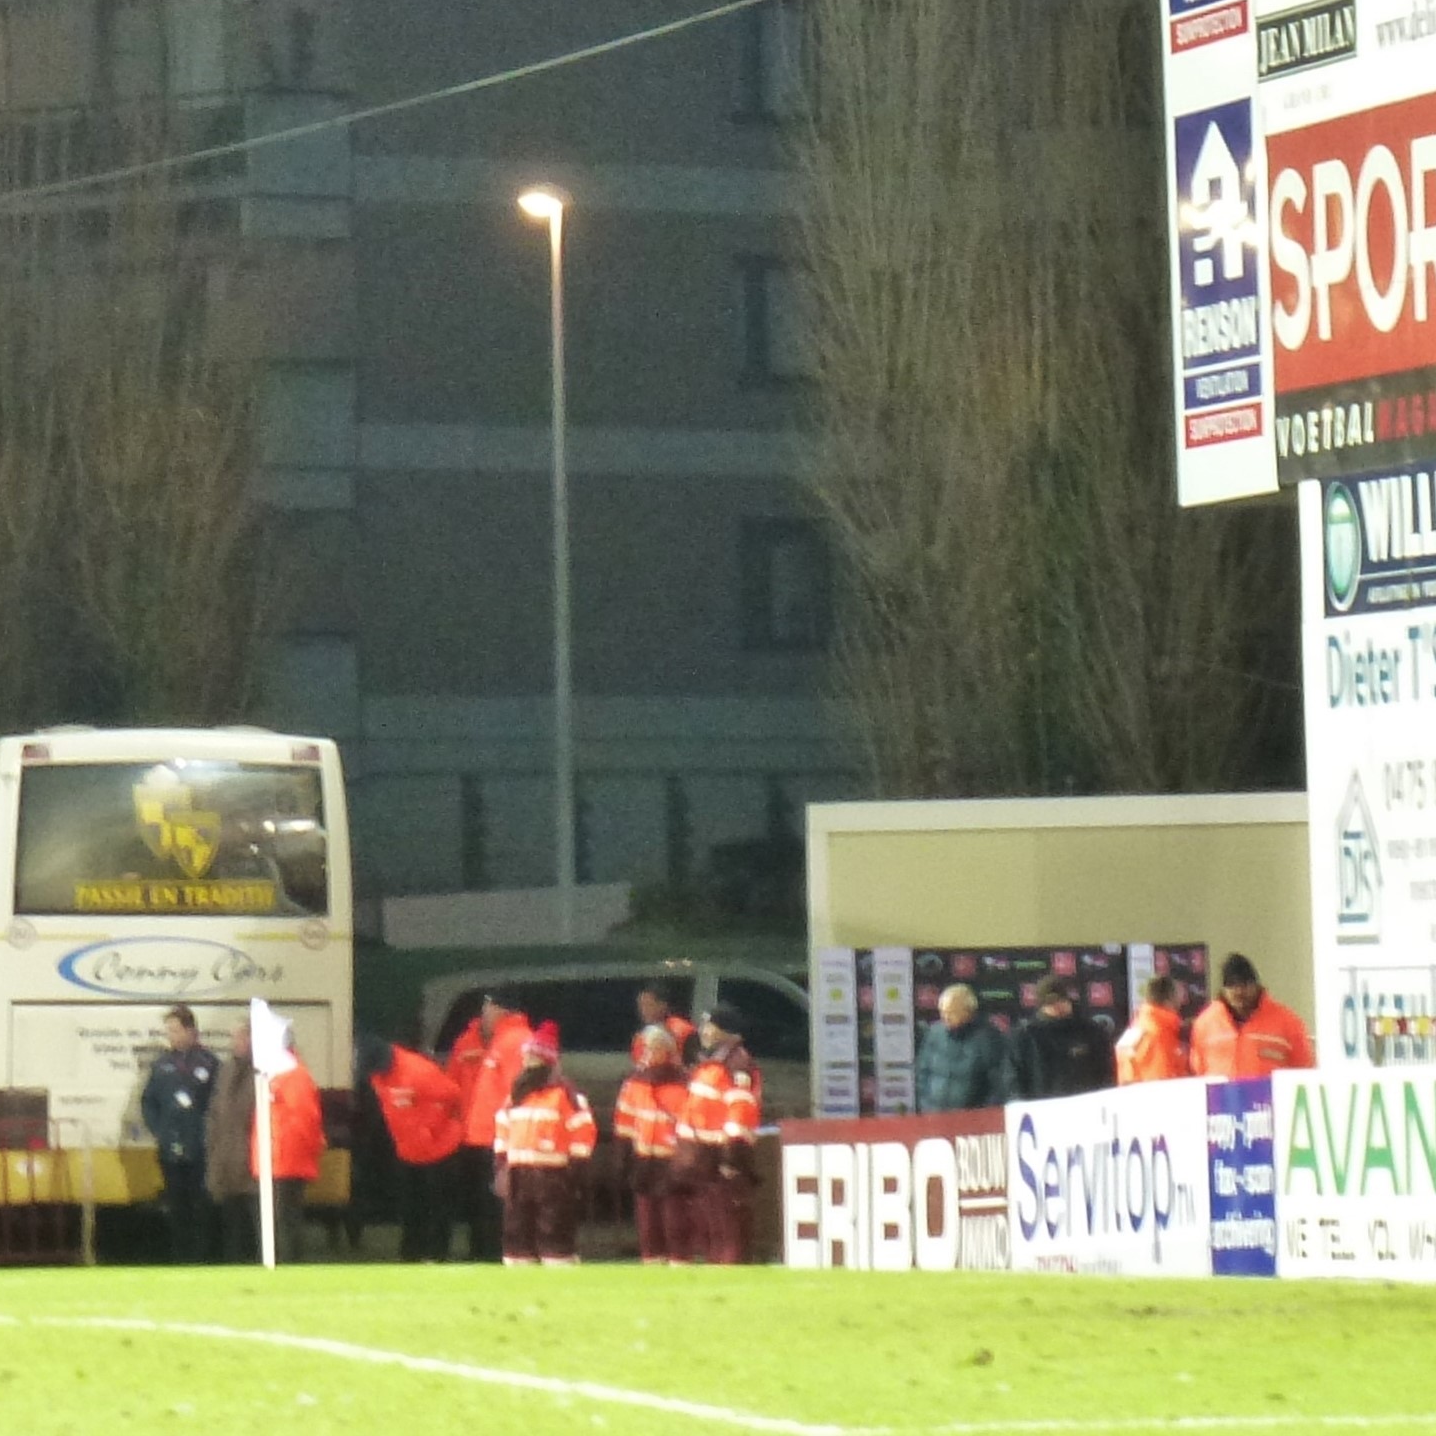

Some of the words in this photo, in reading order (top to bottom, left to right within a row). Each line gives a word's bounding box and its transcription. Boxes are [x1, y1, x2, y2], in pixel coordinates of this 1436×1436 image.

[1259, 20, 1301, 75] JEAN
[1302, 5, 1356, 58] MILAN
[1183, 295, 1258, 359] RENSON
[1326, 628, 1401, 709] Dieter
[782, 1137, 960, 1271] ERIBO
[1017, 1104, 1174, 1264] Servitop
